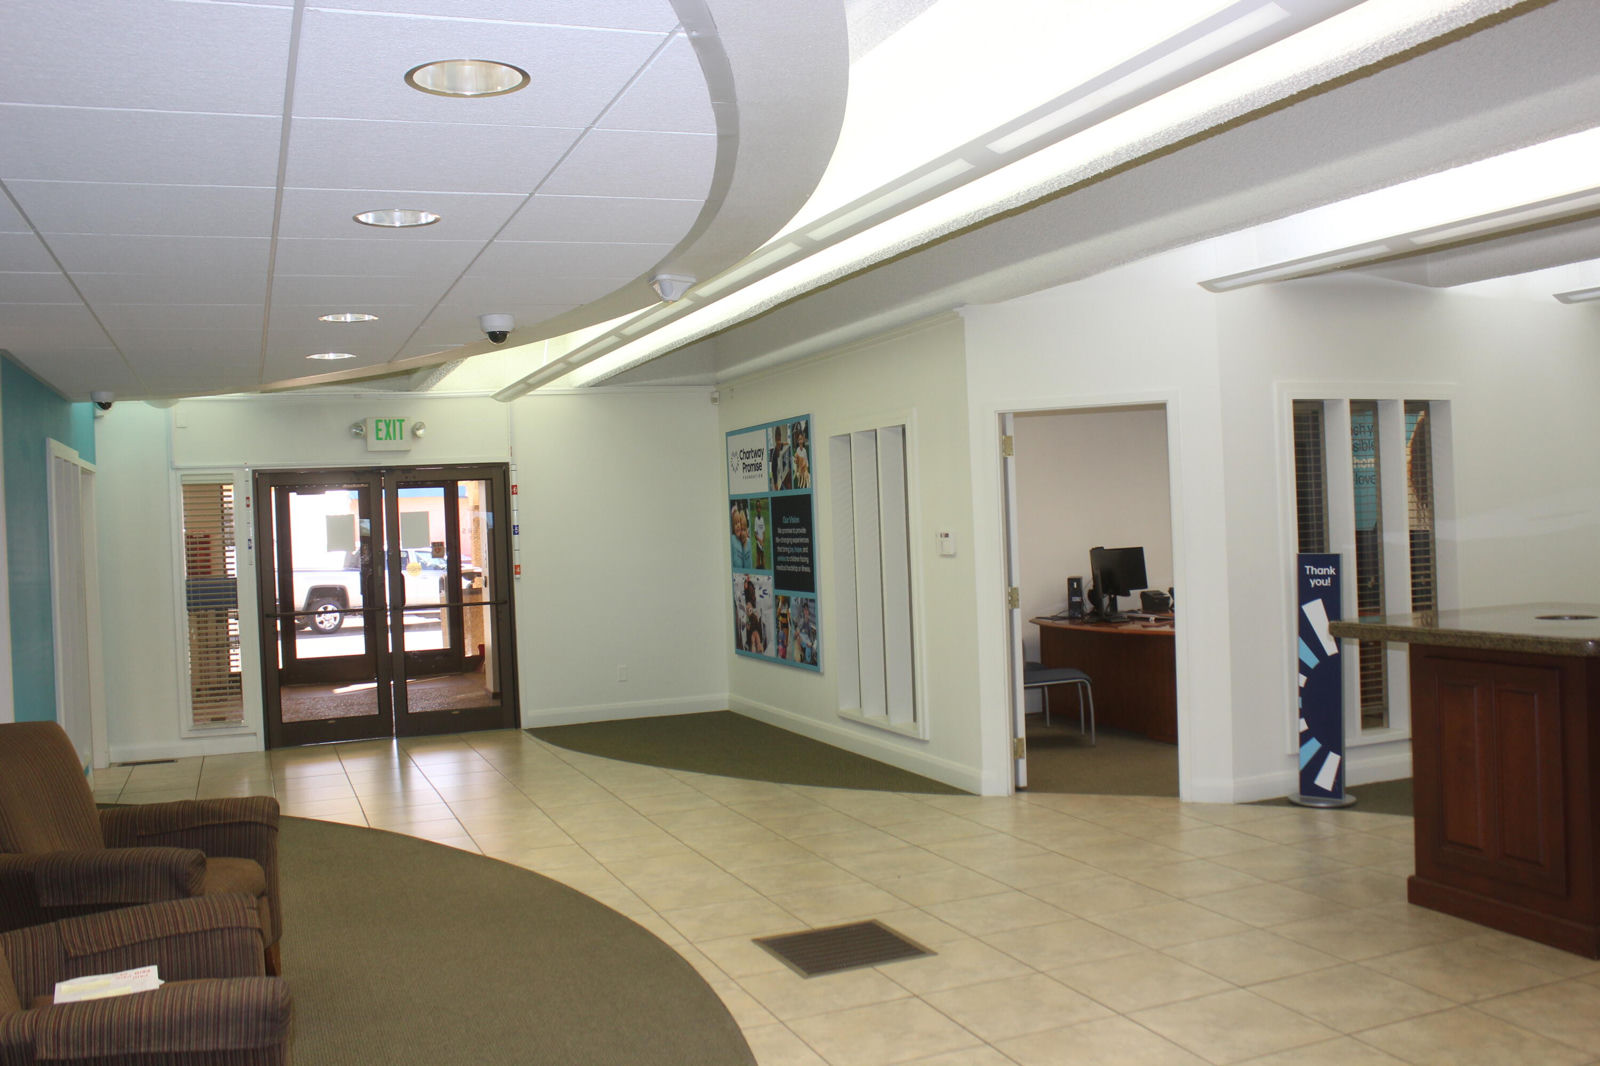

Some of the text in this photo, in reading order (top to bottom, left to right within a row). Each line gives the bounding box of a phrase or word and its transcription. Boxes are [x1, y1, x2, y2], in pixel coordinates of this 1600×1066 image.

[375, 419, 405, 440] EXIT
[739, 448, 764, 461] Chartway
[742, 459, 763, 474] Promise
[1304, 565, 1336, 575] Thank
[1309, 577, 1331, 588] you!
